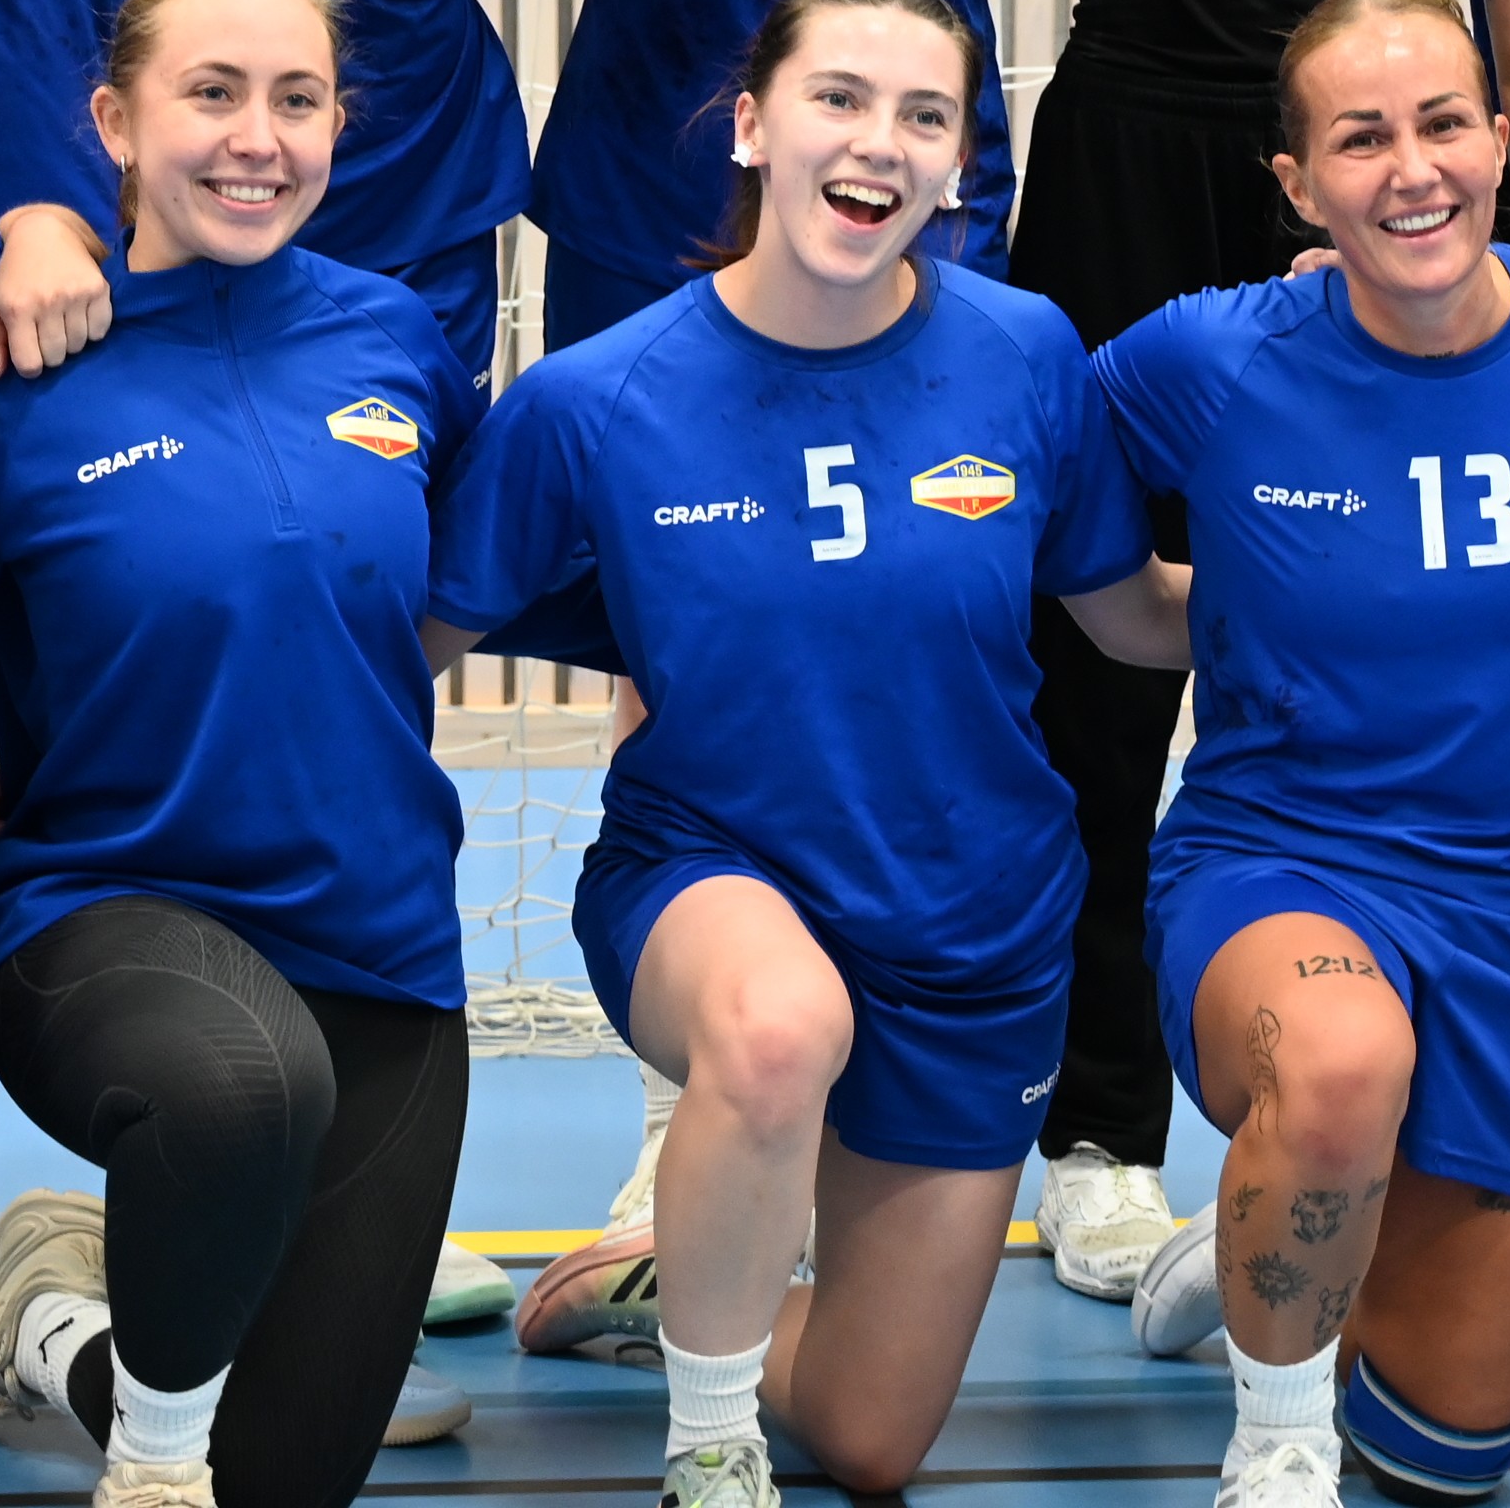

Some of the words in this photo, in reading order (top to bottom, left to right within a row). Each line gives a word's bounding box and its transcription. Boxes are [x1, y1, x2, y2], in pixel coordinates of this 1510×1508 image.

[363, 406, 389, 421] 1945
[78, 446, 159, 484] CRAFT
[954, 464, 983, 478] 1945
[803, 443, 863, 562] 5
[1253, 484, 1339, 511] CRAFT
[653, 501, 737, 526] CRAFT
[1295, 955, 1377, 979] 12:12
